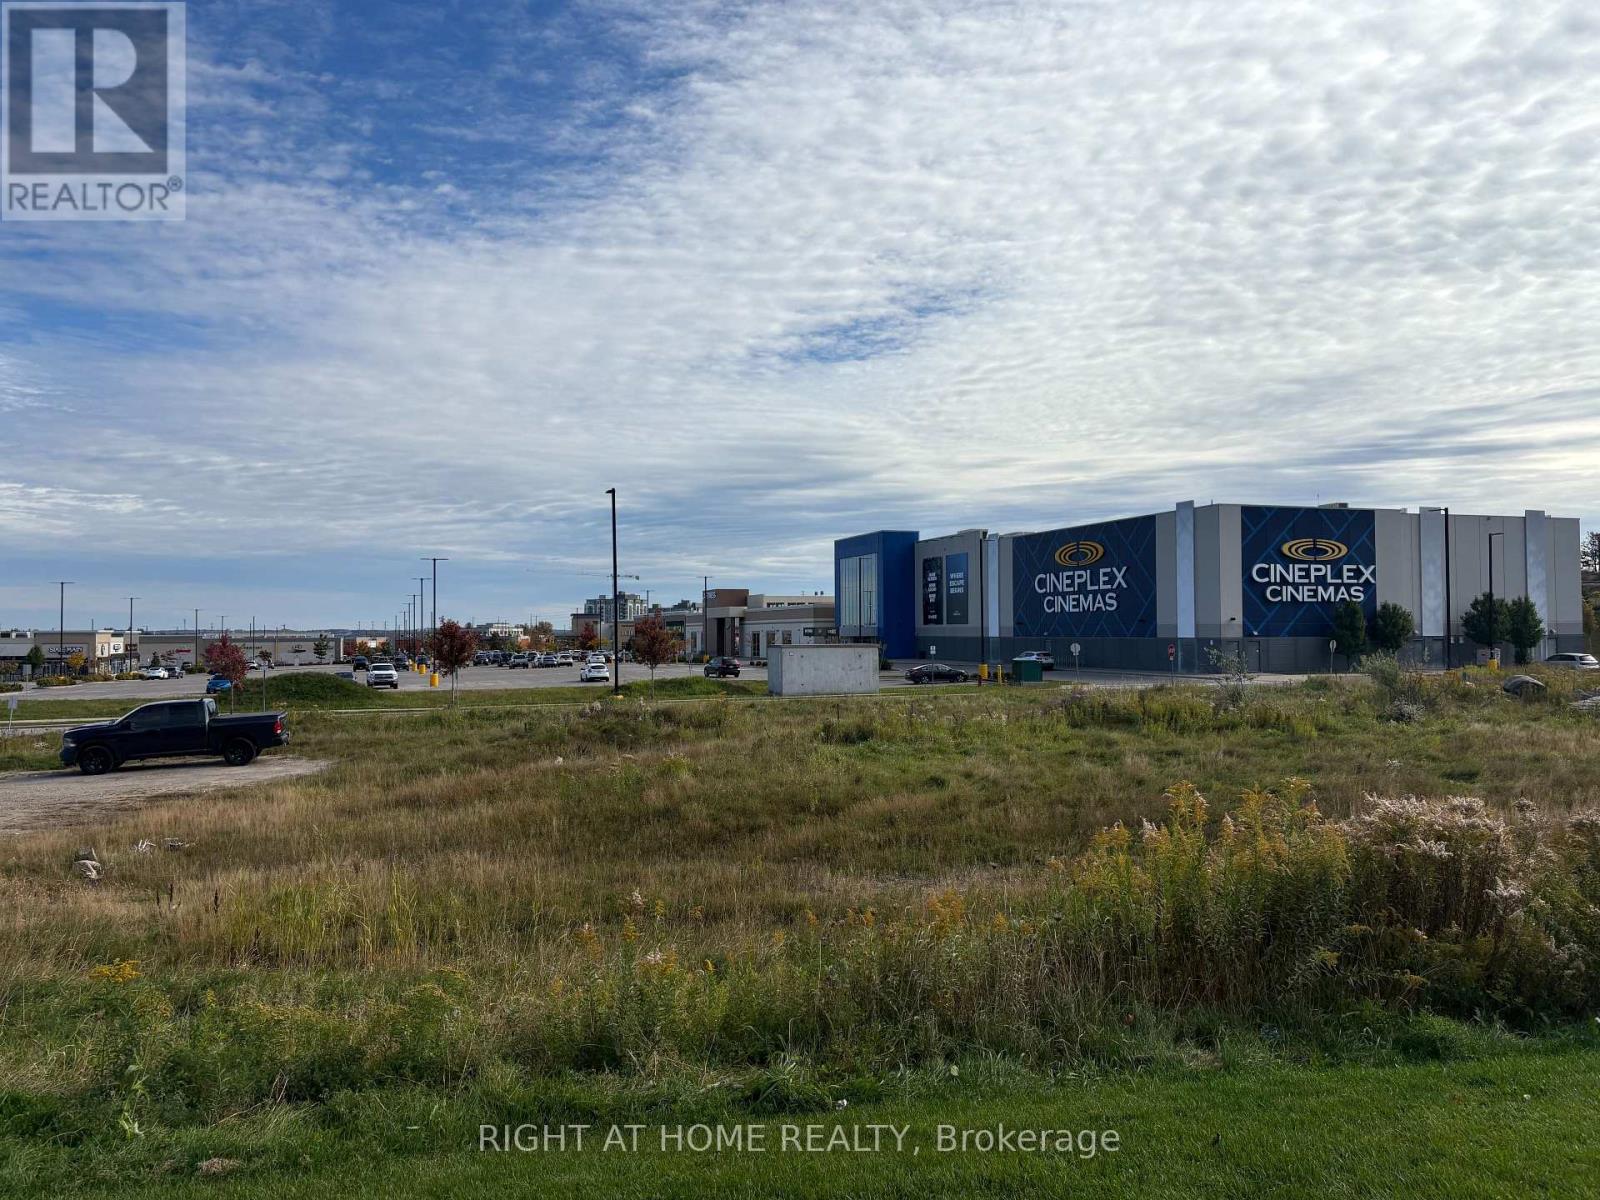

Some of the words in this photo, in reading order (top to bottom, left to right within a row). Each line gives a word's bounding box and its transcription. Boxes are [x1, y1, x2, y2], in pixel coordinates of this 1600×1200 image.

[1034, 566, 1128, 594] CINEPLEX
[1251, 563, 1376, 583] CINEPLEX
[1043, 592, 1118, 613] CINEMAS
[1266, 585, 1365, 602] CINEMAS
